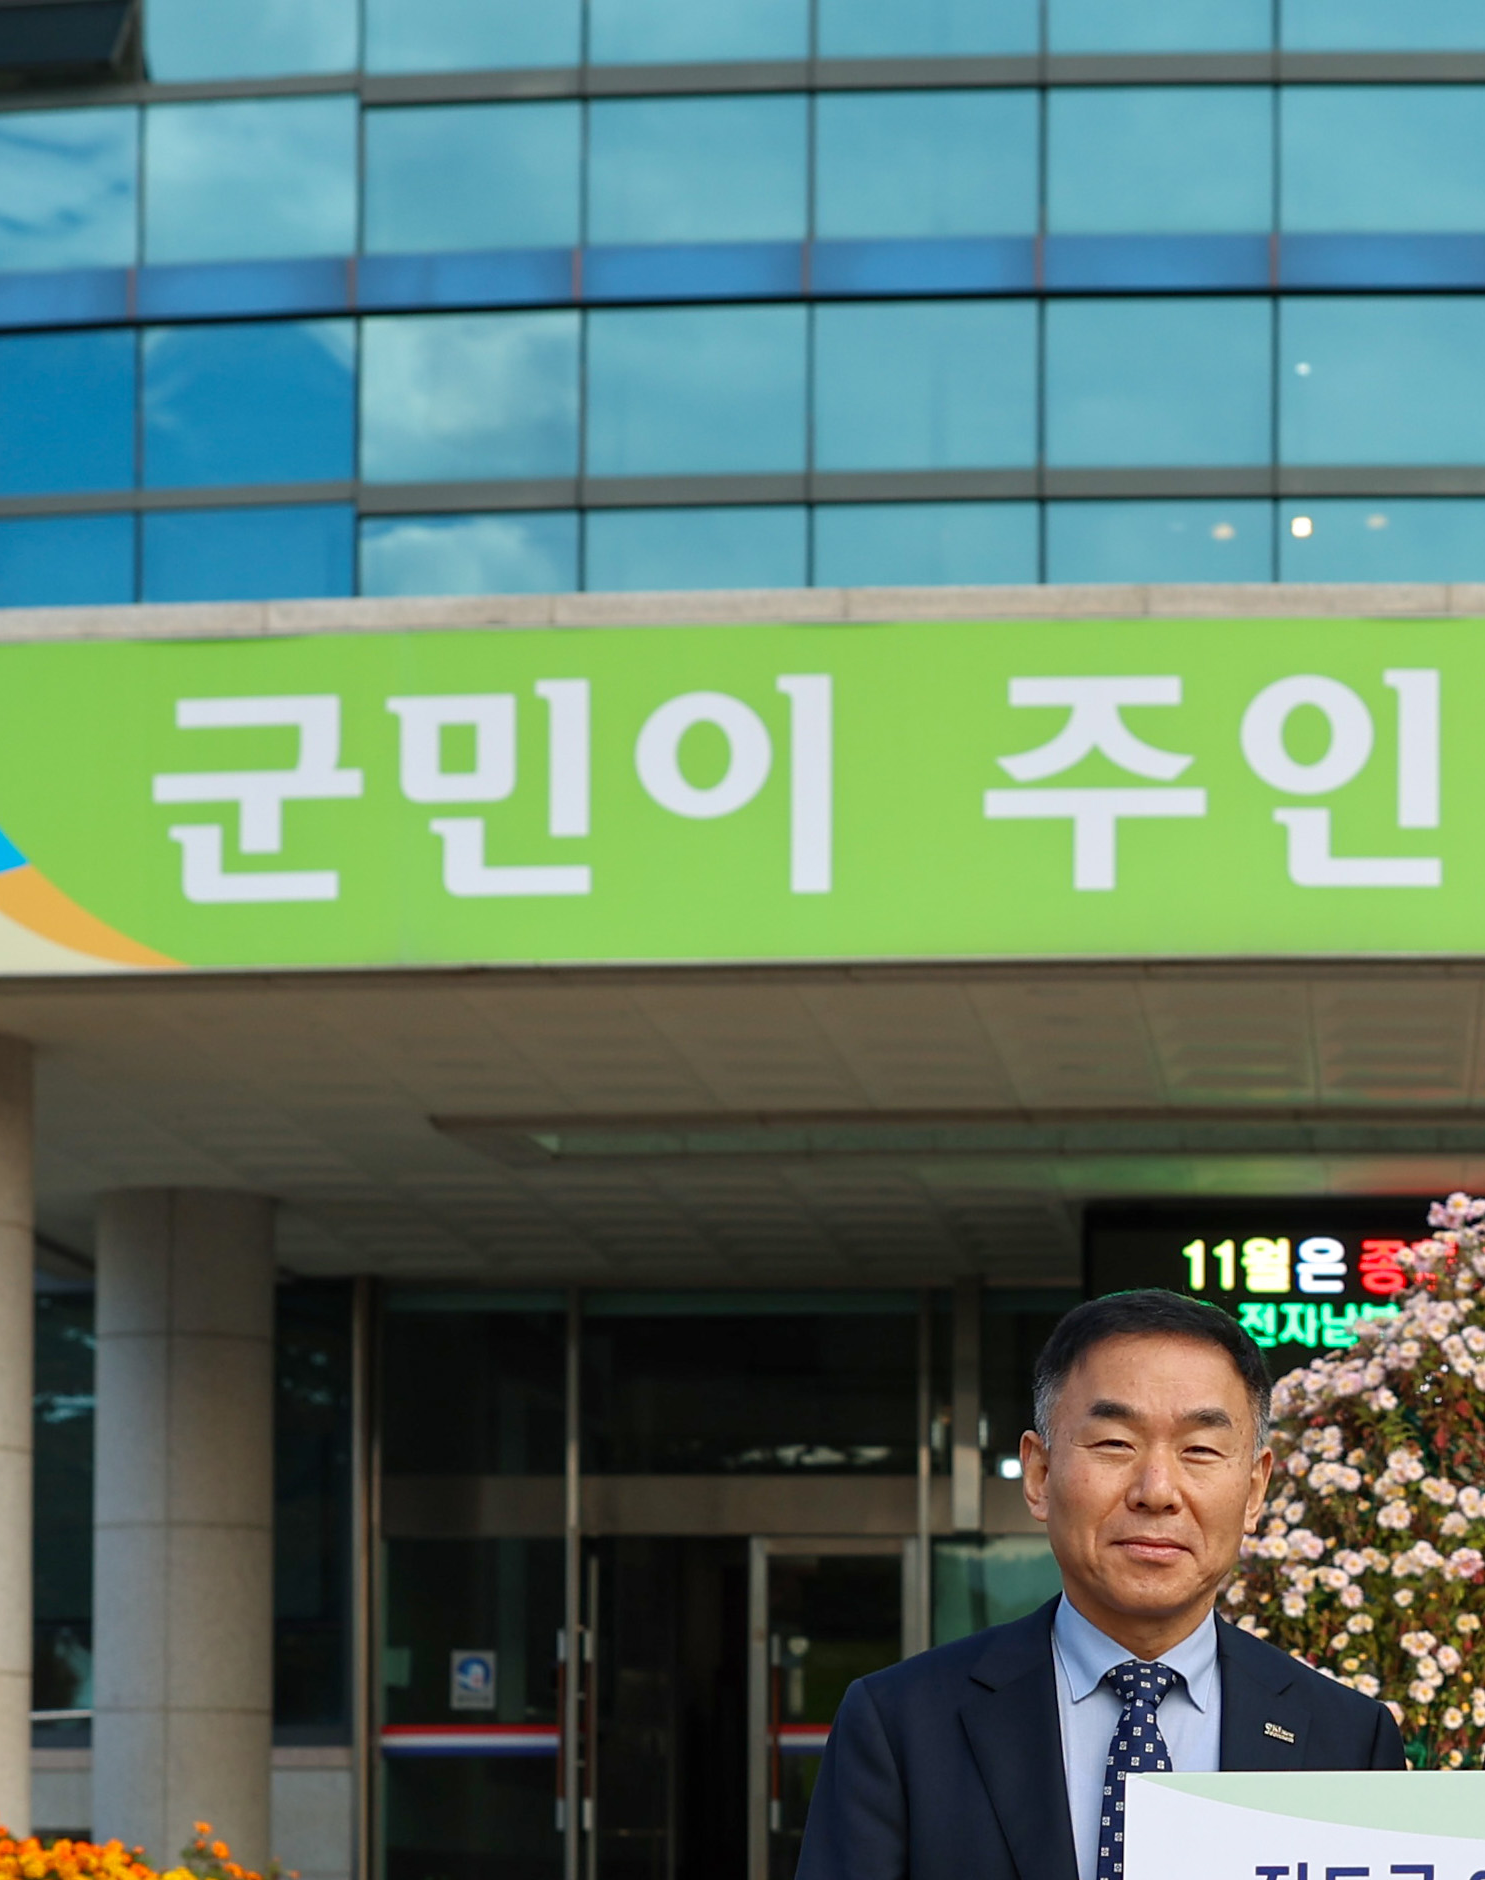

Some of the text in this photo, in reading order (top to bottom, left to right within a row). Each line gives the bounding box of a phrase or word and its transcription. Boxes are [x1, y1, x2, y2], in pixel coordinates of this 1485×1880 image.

[152, 672, 832, 904] 군민이
[1181, 1236, 1348, 1294] 11월은
[1237, 1302, 1401, 1348] 전자납
